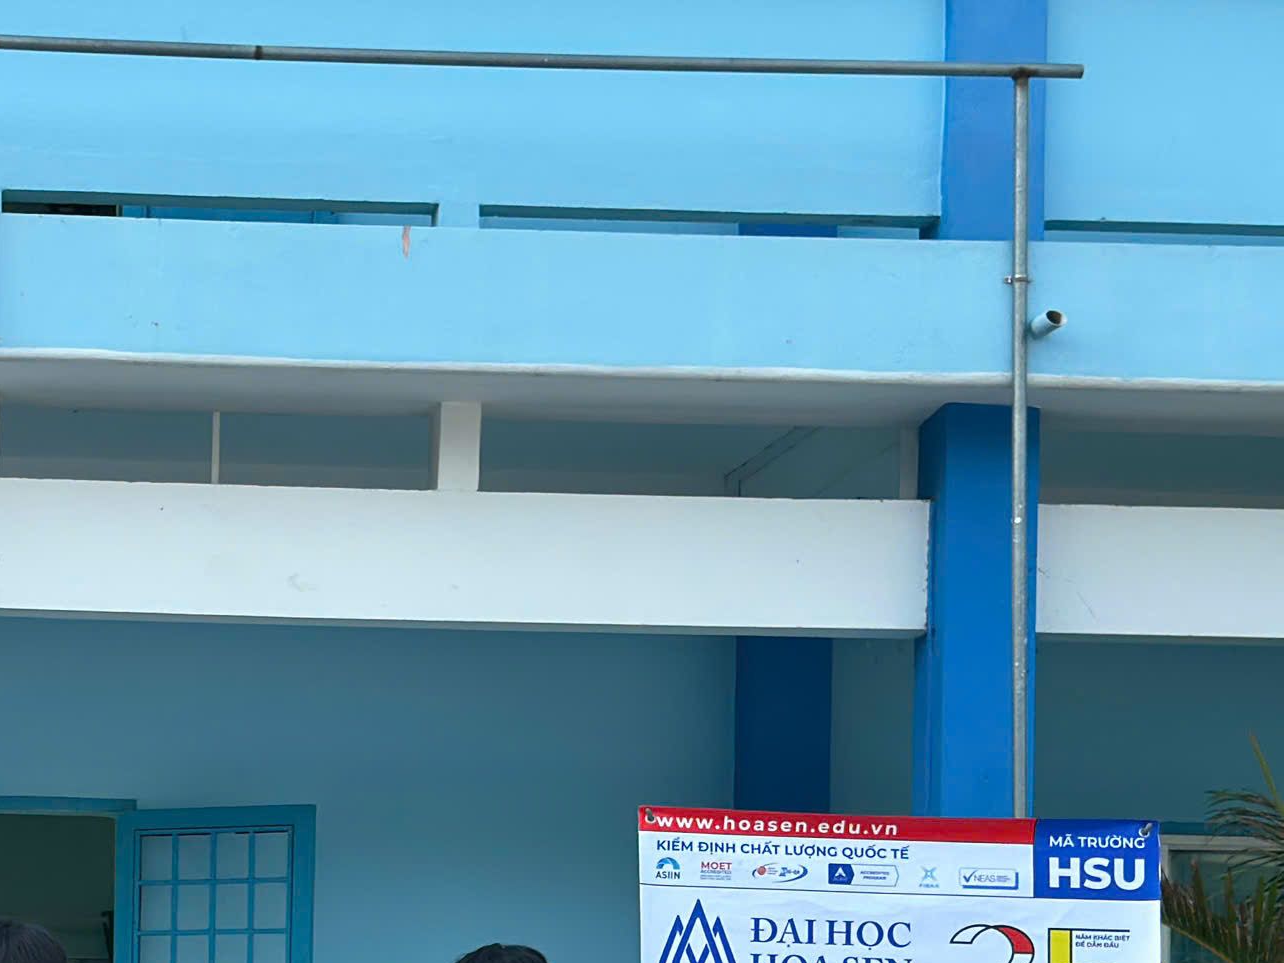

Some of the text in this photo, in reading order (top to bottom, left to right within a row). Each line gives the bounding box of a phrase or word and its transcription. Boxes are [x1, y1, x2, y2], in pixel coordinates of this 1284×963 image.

[656, 816, 898, 836] www.hoasen.edu.vn
[657, 837, 910, 860] KIỂM ĐỊNH CHẤT LƯỢNG QUỐC TẾ
[1049, 834, 1145, 849] MÃ TRƯỜNG
[655, 871, 681, 880] ASIIN
[701, 861, 732, 870] MOET
[1049, 857, 1145, 890] HSU
[751, 917, 911, 950] ĐẠI HỌC
